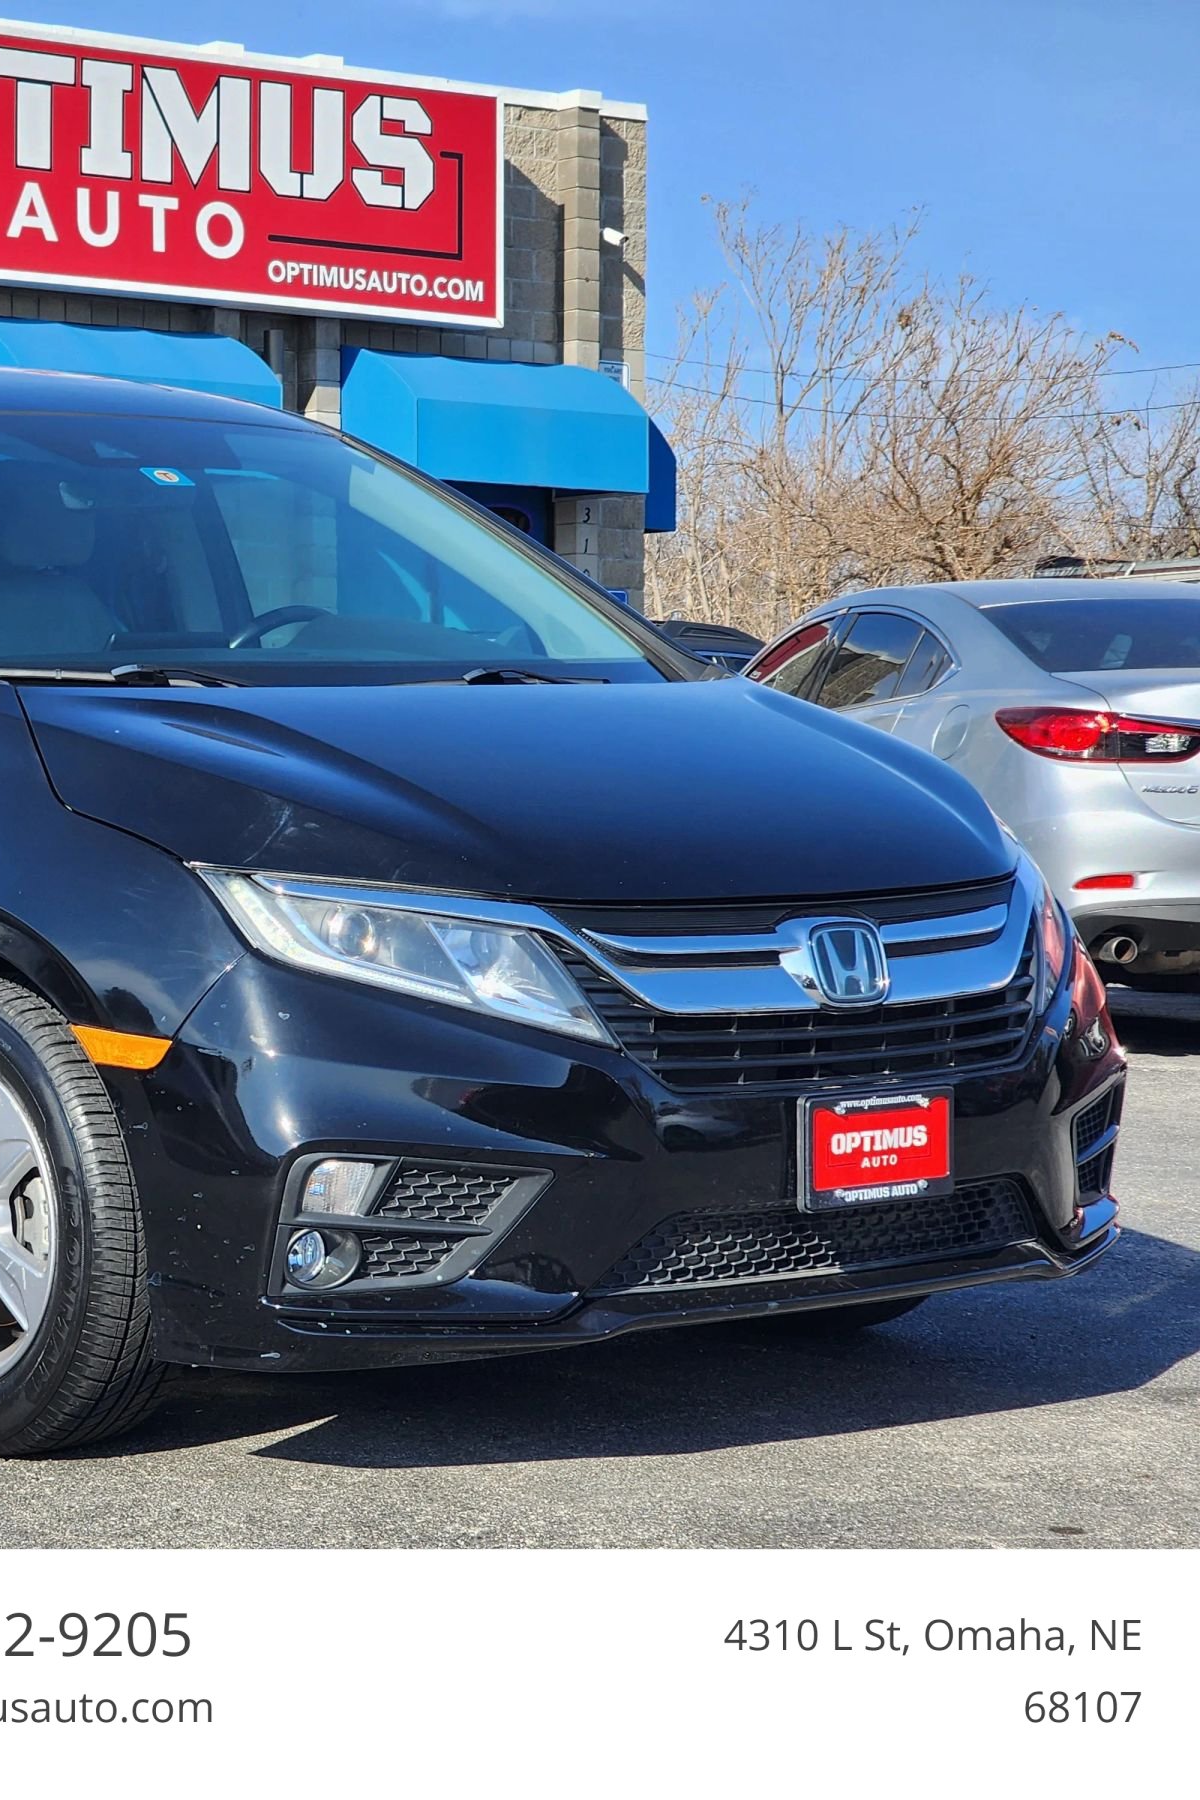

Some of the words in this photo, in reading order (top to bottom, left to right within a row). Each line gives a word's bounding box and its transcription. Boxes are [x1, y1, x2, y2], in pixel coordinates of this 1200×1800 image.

[7, 182, 245, 260] AUTO
[267, 259, 485, 302] OPTIMUSAUTO.COM
[831, 1125, 928, 1155] OPTIMUS
[860, 1154, 898, 1168] AUTO
[844, 1186, 890, 1202] OPTIMUS
[891, 1183, 918, 1197] AUTO
